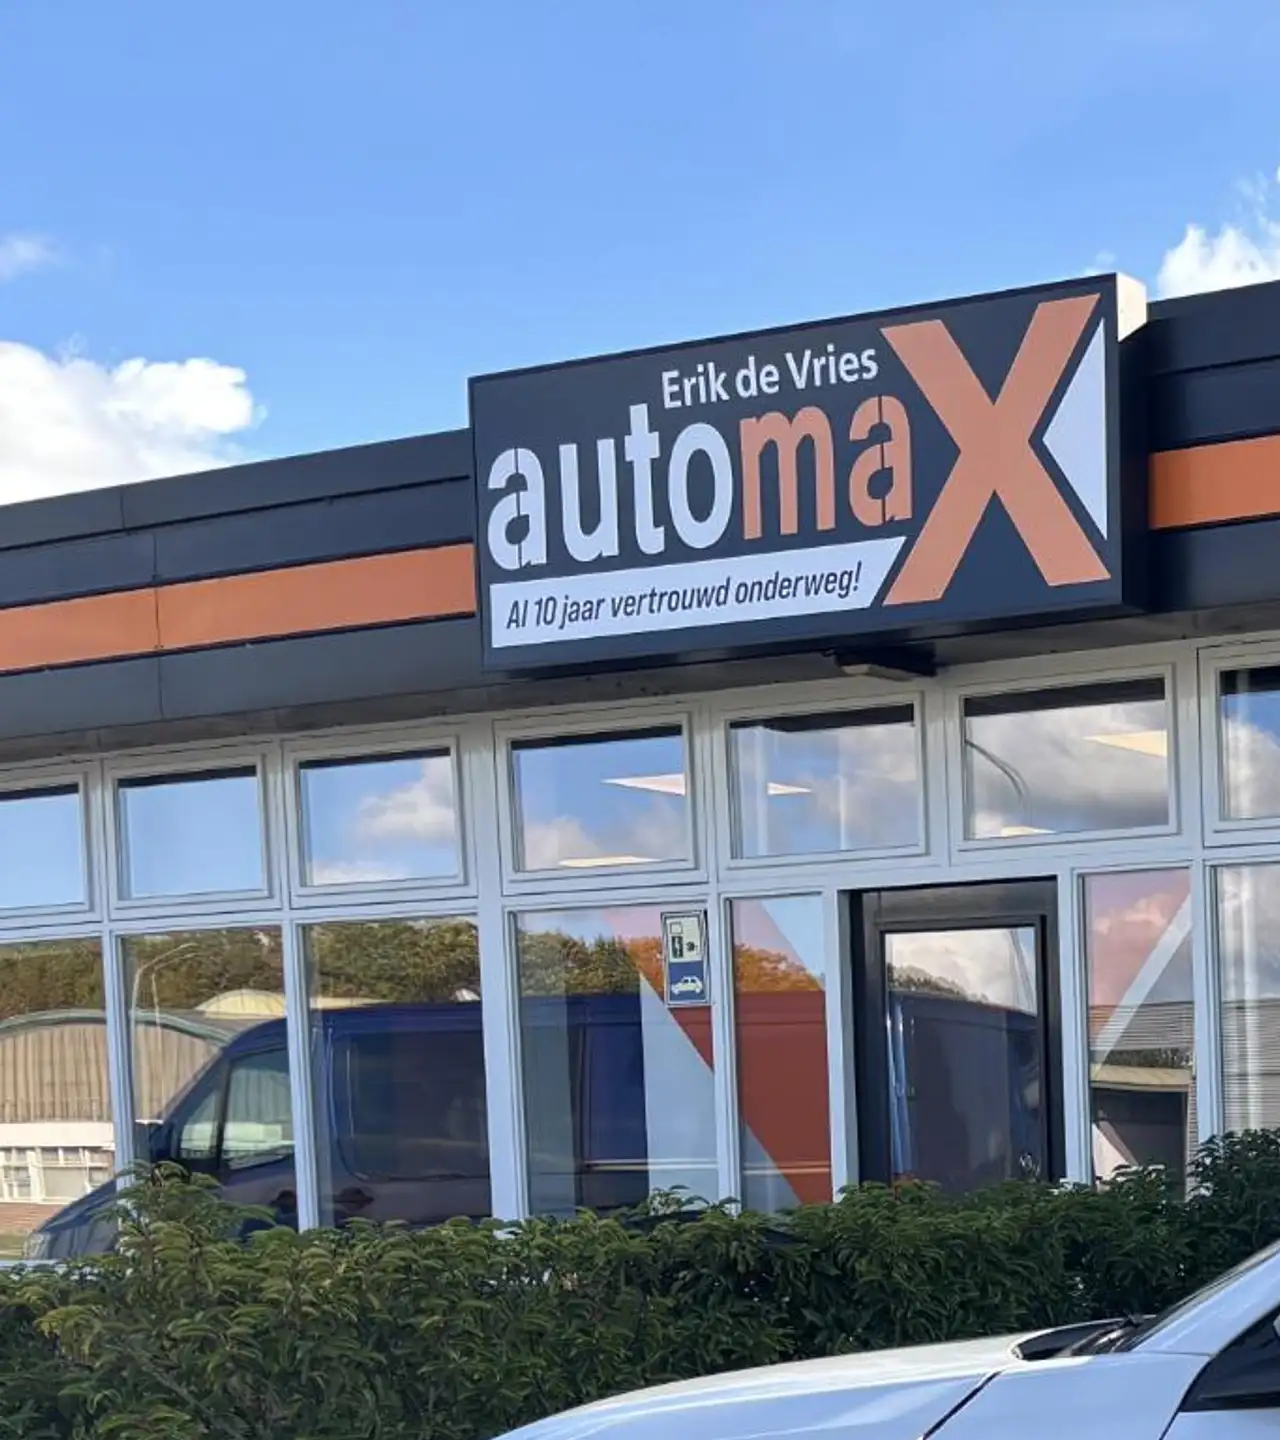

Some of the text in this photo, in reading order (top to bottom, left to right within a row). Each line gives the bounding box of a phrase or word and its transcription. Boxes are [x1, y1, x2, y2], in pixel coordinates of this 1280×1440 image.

[661, 343, 879, 409] Erik de Vries
[506, 560, 863, 630] Al 10 jaar vertrouwd onderweg!
